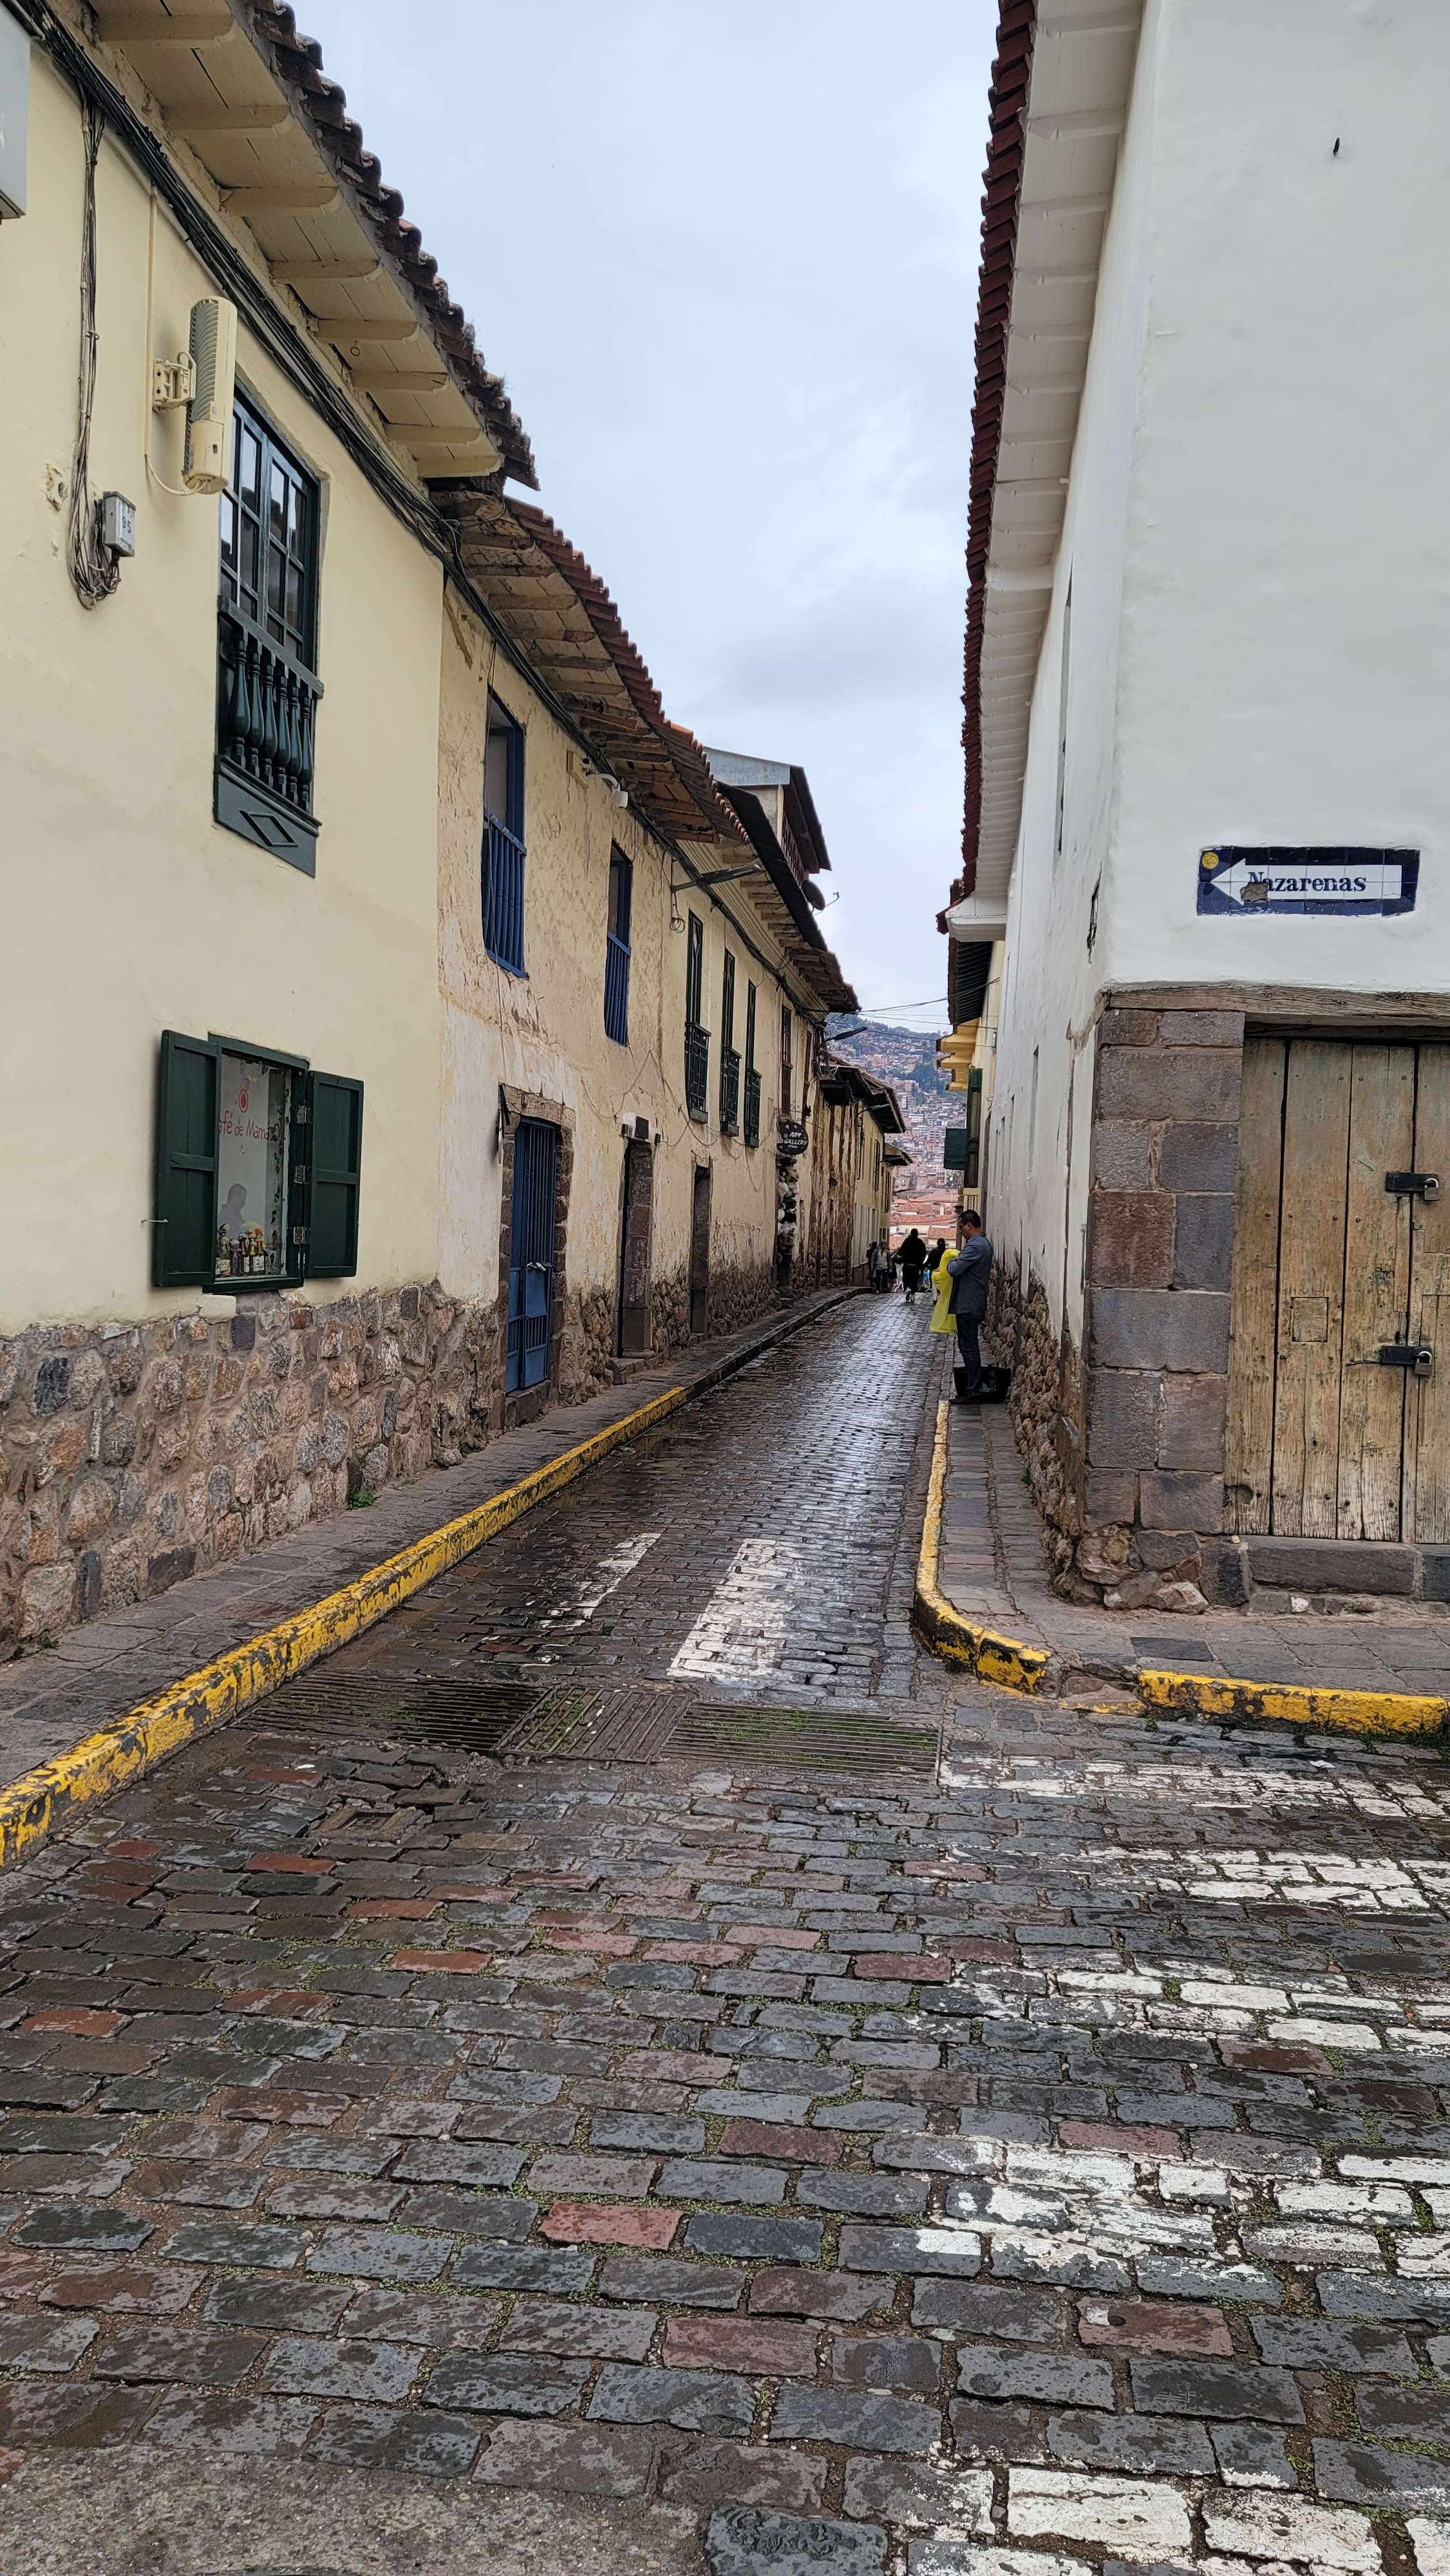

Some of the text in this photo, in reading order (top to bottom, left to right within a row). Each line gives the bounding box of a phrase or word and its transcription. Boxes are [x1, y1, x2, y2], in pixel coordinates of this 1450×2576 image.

[122, 516, 131, 534] 95
[218, 1110, 232, 1134] afé
[234, 1118, 243, 1136] de
